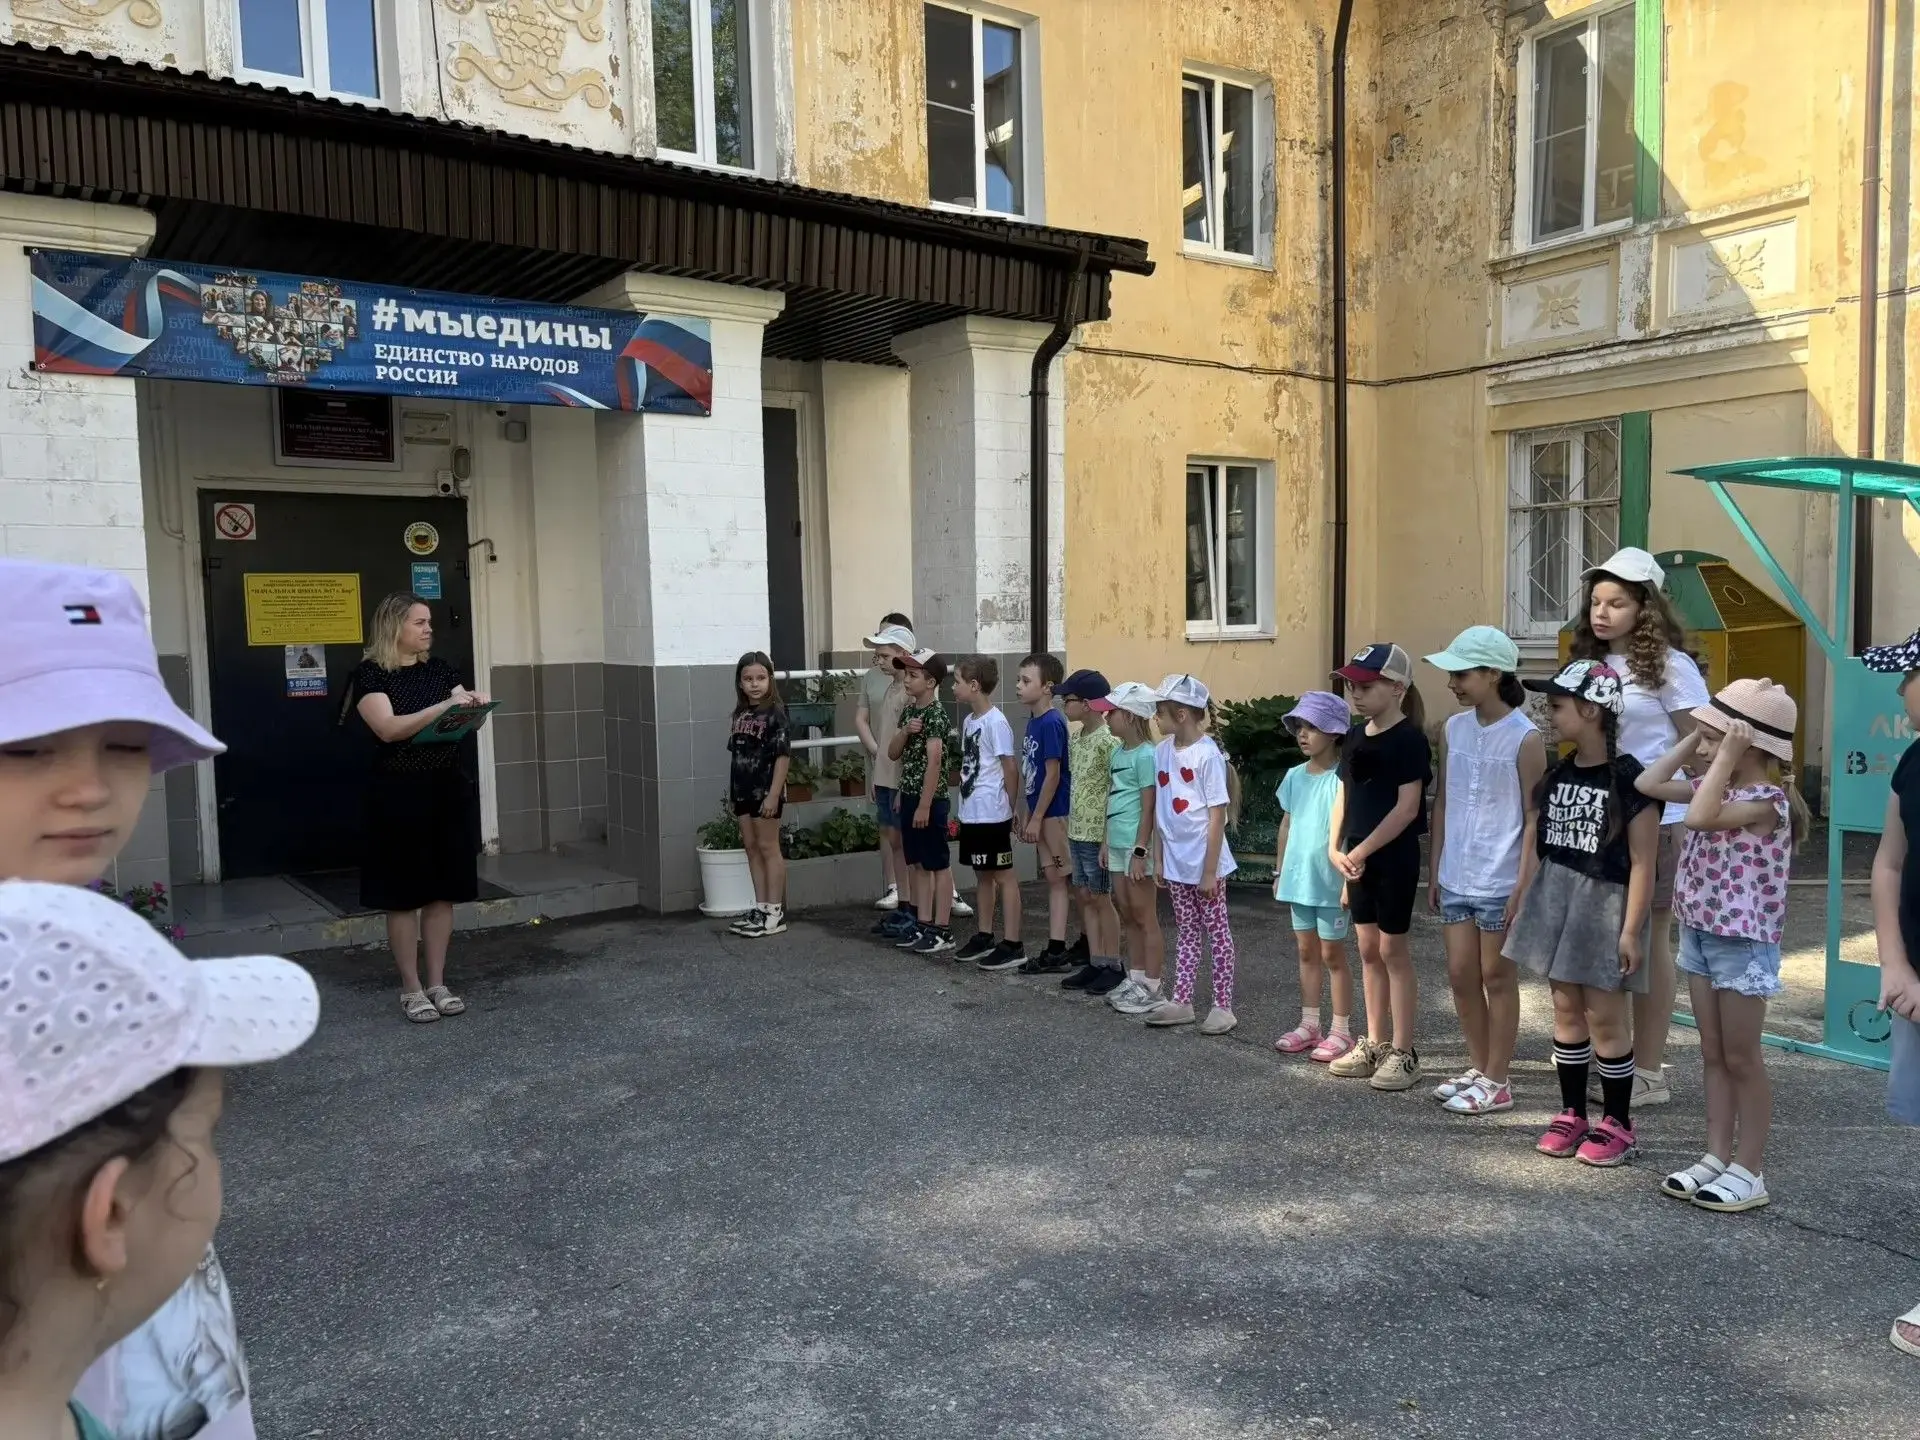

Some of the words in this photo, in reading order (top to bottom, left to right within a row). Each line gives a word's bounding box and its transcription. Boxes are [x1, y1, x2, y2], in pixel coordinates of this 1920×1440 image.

[371, 298, 613, 351] #мыедины
[374, 343, 485, 367] ЕДИНСТВО
[490, 353, 580, 376] НАРОДОВ
[375, 365, 458, 386] РОССИИ
[1549, 783, 1610, 809] JUST
[1547, 803, 1605, 824] BELIEVE
